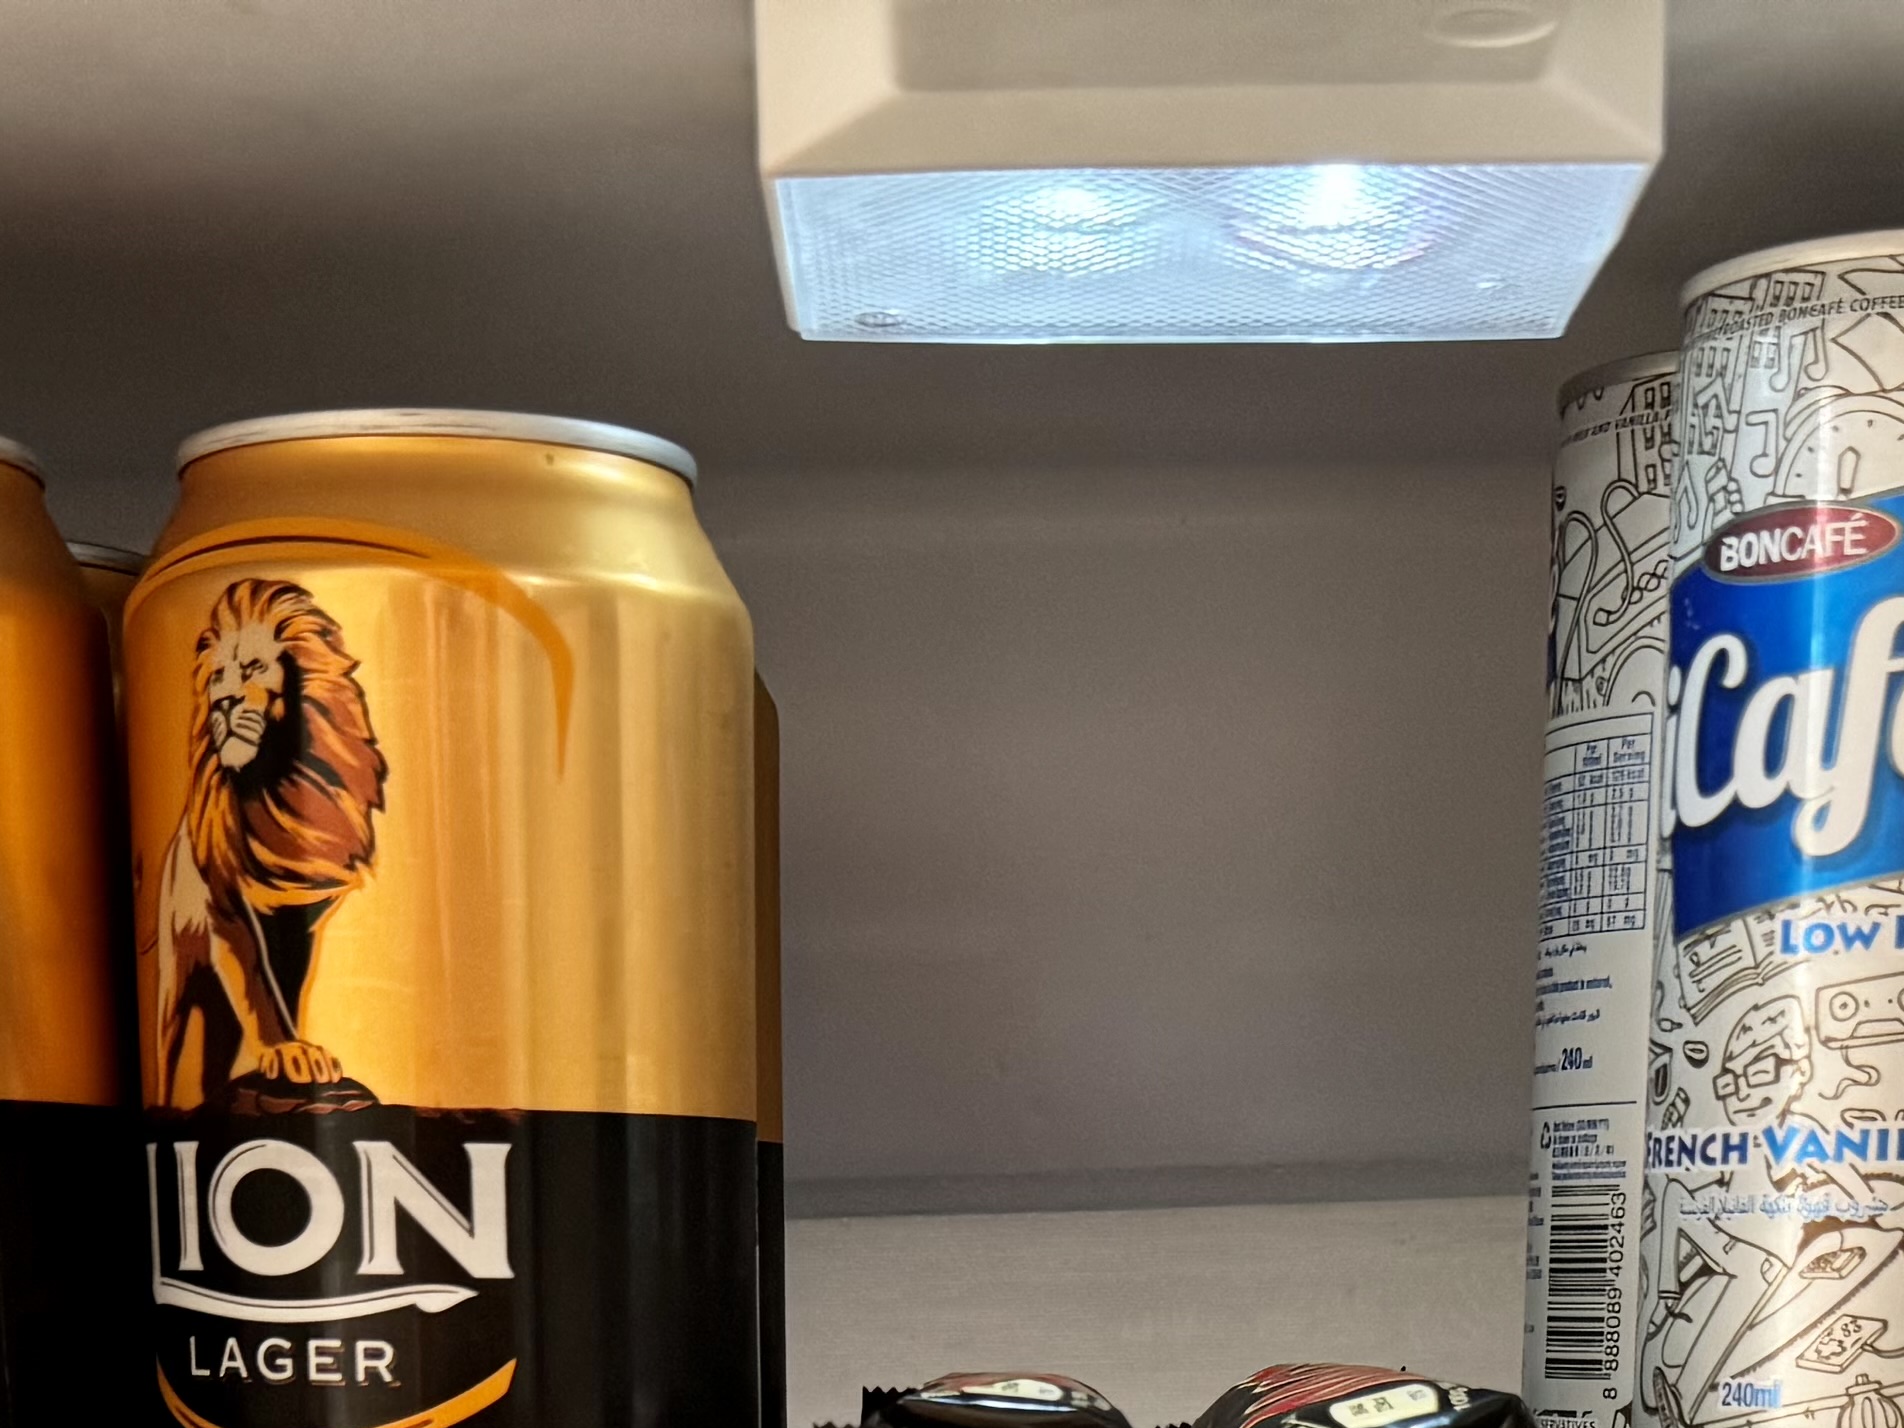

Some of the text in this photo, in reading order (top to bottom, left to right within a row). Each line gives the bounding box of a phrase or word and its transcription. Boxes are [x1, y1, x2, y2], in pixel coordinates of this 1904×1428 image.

[1720, 512, 1870, 573] BONCAFÉ
[1779, 919, 1882, 955] LOW
[188, 1335, 397, 1385] LAGER
[1720, 1381, 1781, 1409] 240ml
